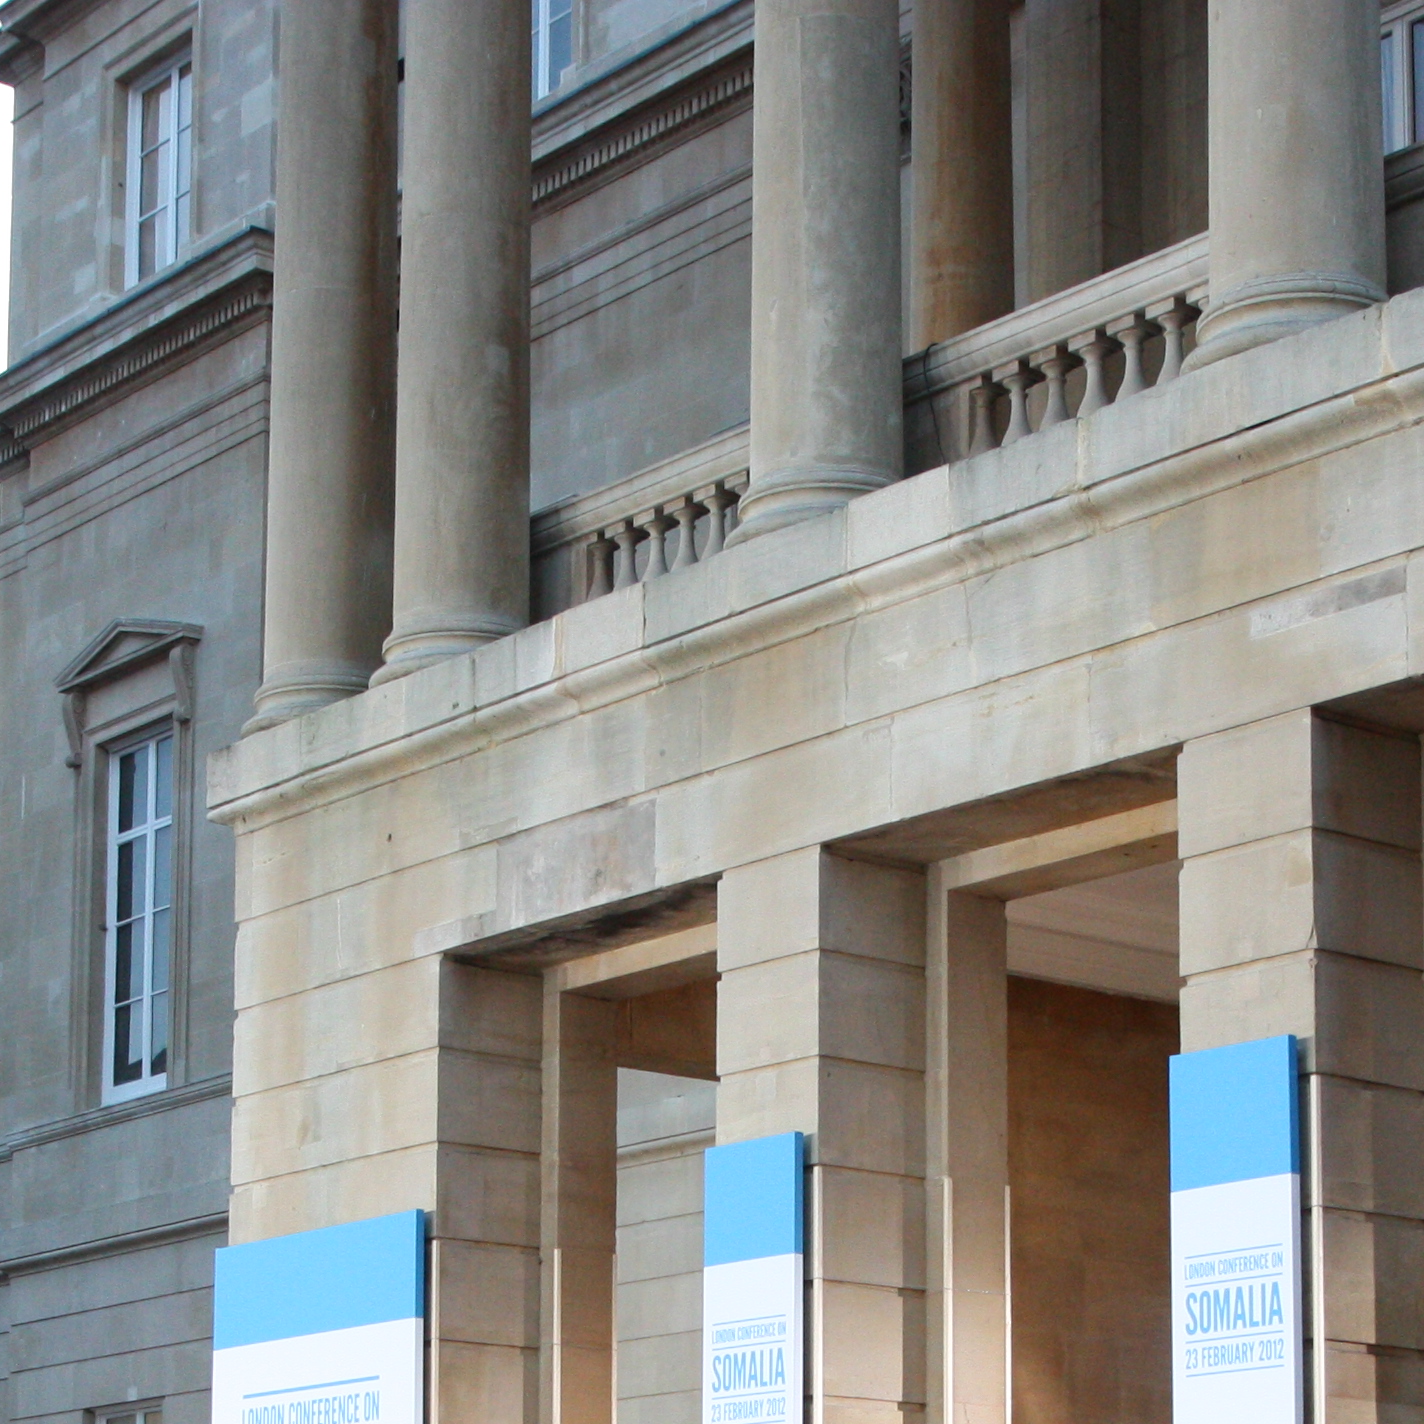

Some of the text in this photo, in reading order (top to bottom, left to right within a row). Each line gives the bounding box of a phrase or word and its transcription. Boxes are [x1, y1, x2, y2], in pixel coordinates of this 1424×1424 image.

[1184, 1251, 1283, 1281] LONDON CONFERENCE ON
[1185, 1281, 1283, 1336] SOMALIA
[711, 1320, 787, 1344] LONDON CONFERENCE ON
[711, 1347, 786, 1393] SOMALIA
[1185, 1338, 1284, 1370] 23 FEBRUARY 2012
[364, 1390, 380, 1422] ON
[711, 1397, 786, 1423] 23 FEBRUARY 2012
